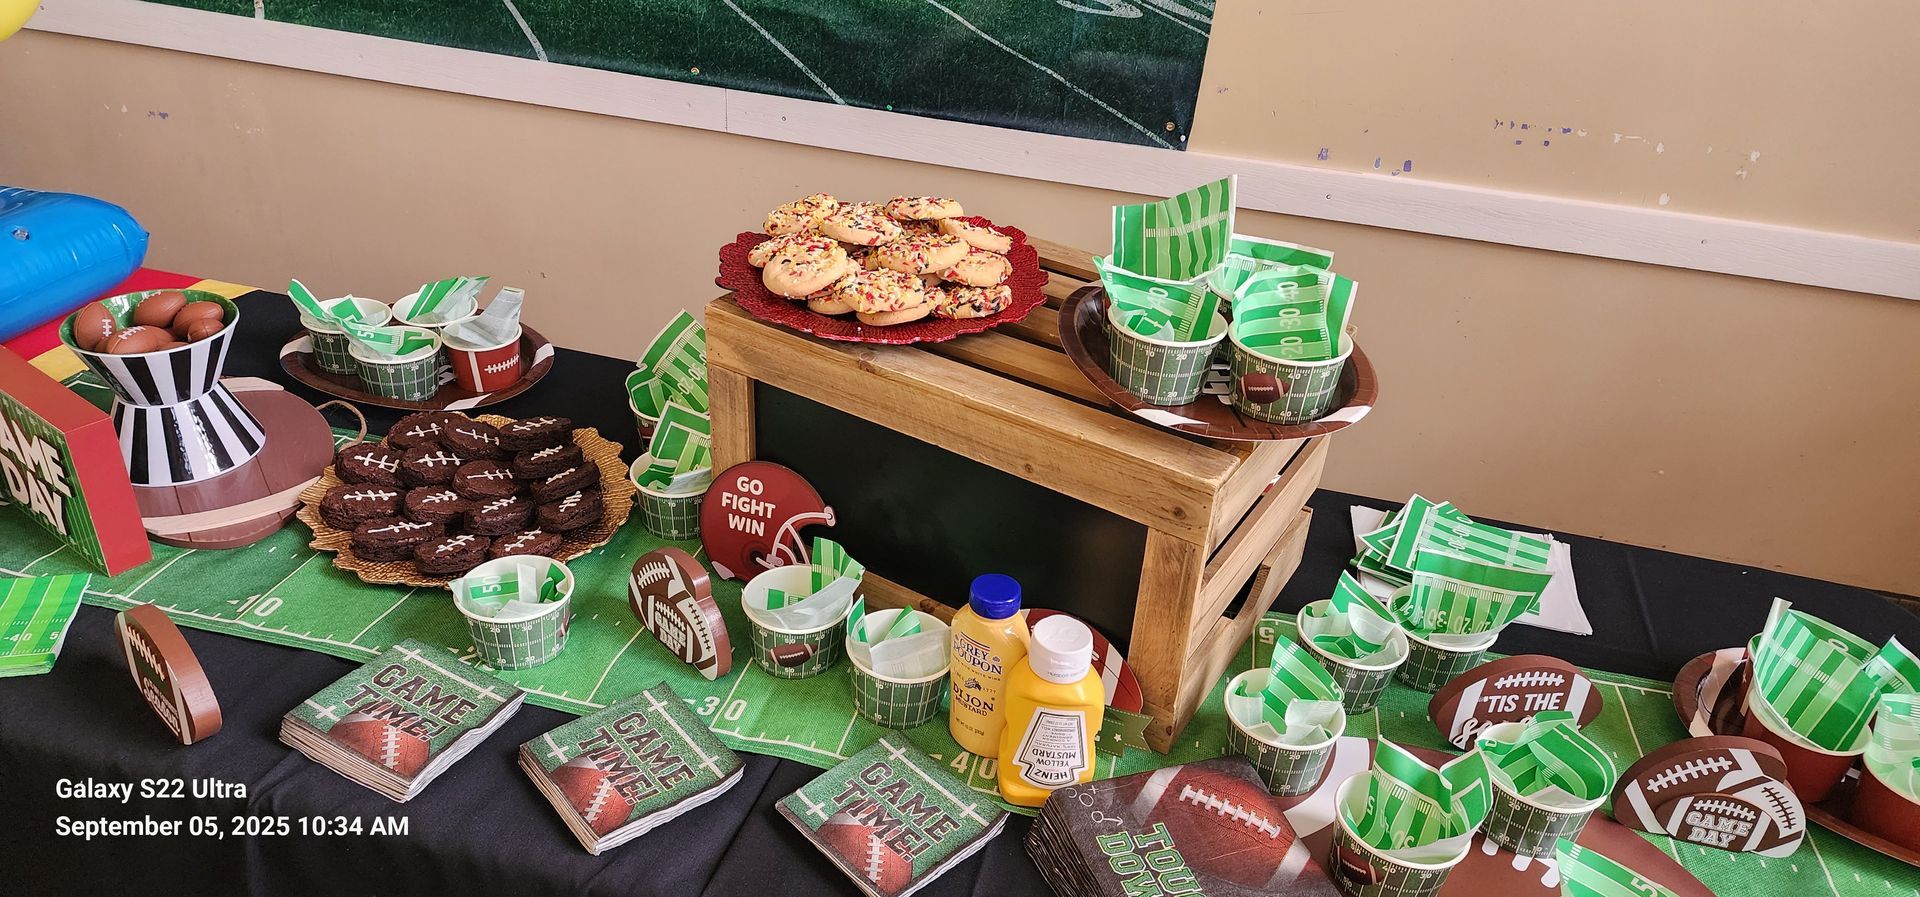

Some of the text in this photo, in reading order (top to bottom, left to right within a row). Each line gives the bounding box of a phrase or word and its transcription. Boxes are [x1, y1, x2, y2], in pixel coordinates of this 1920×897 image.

[0, 411, 73, 499] AME
[0, 452, 68, 537] DAY
[736, 476, 764, 496] GO
[721, 491, 776, 519] FIGHT
[728, 513, 765, 537] WIN
[654, 610, 687, 648] GAME
[659, 626, 682, 656] DAY
[953, 640, 1003, 676] POUPON
[959, 638, 990, 662] GREY
[371, 662, 481, 726] GAME
[953, 681, 994, 712] DIJON
[955, 695, 988, 717] MUSTARD
[1524, 692, 1565, 711] THE
[343, 683, 450, 742] TIME!
[576, 725, 661, 806] TIME!
[611, 711, 698, 792] GAME
[949, 751, 998, 780] 40
[1032, 748, 1077, 759] MUSTARD
[1035, 757, 1069, 767] YELLOW
[1034, 768, 1068, 780] HEINZ
[859, 761, 962, 844] GAME
[831, 778, 934, 864] TIME!
[1685, 810, 1754, 837] GAME
[1687, 826, 1737, 848] DAY
[1095, 830, 1165, 897] DOW
[1133, 822, 1207, 897] TOU
